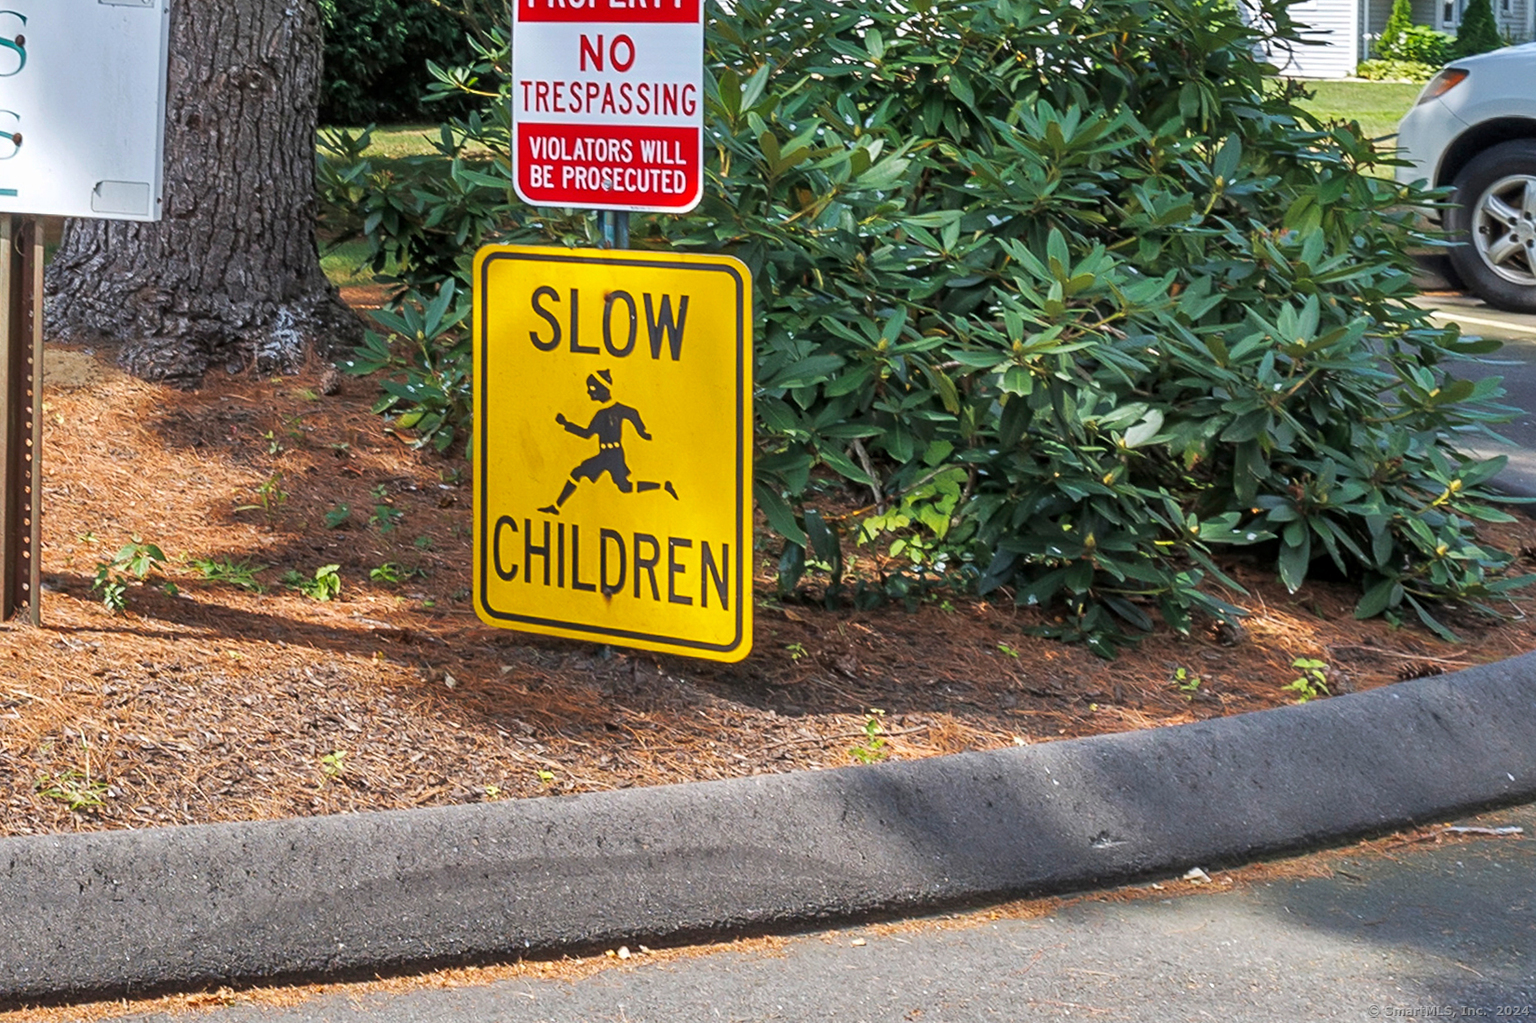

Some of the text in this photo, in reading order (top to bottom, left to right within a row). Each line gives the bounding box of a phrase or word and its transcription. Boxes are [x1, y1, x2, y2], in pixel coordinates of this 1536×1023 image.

[579, 34, 636, 73] NO
[520, 81, 697, 116] TRESPASSING
[529, 136, 687, 165] VIOLATORS WILL
[530, 165, 686, 194] BE PROSECUTED
[528, 285, 690, 362] SLOW
[493, 515, 730, 612] CHILDREN
